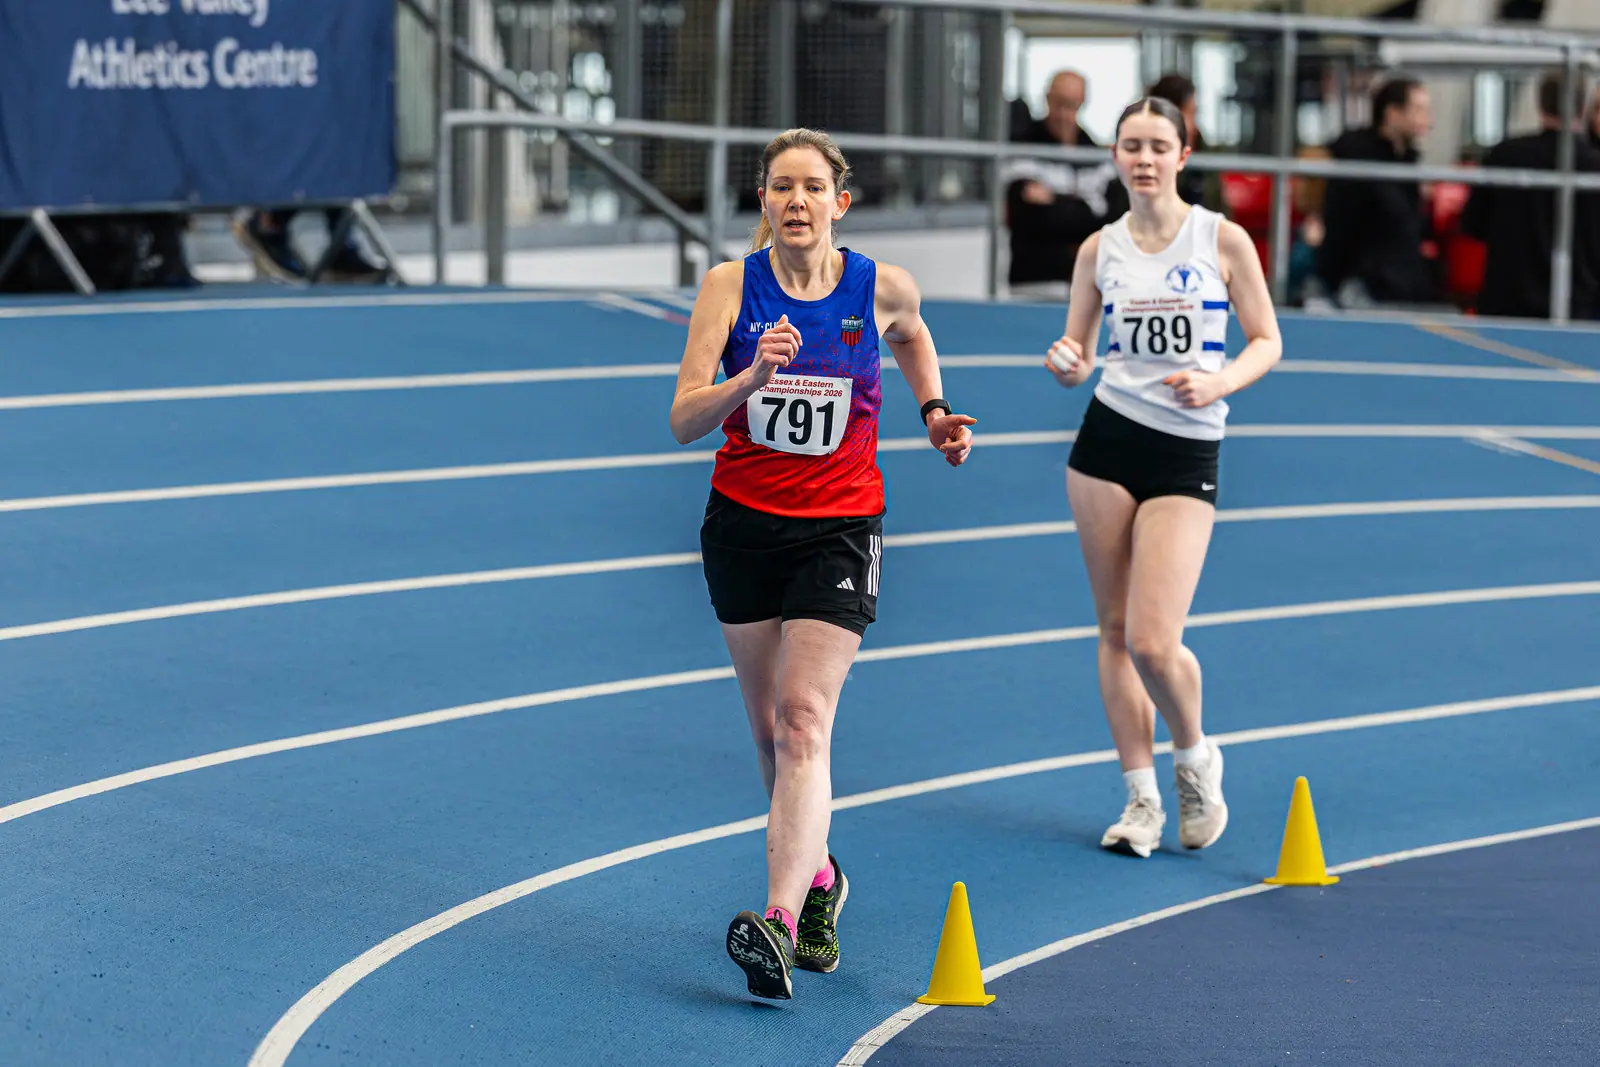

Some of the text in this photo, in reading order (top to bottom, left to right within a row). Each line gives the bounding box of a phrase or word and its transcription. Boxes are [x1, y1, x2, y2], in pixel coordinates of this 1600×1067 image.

[68, 37, 318, 89] Athletics Centre
[1123, 315, 1192, 354] 789
[769, 377, 834, 388] Essex & Eastern
[824, 389, 843, 397] 2026
[761, 396, 834, 446] 791
